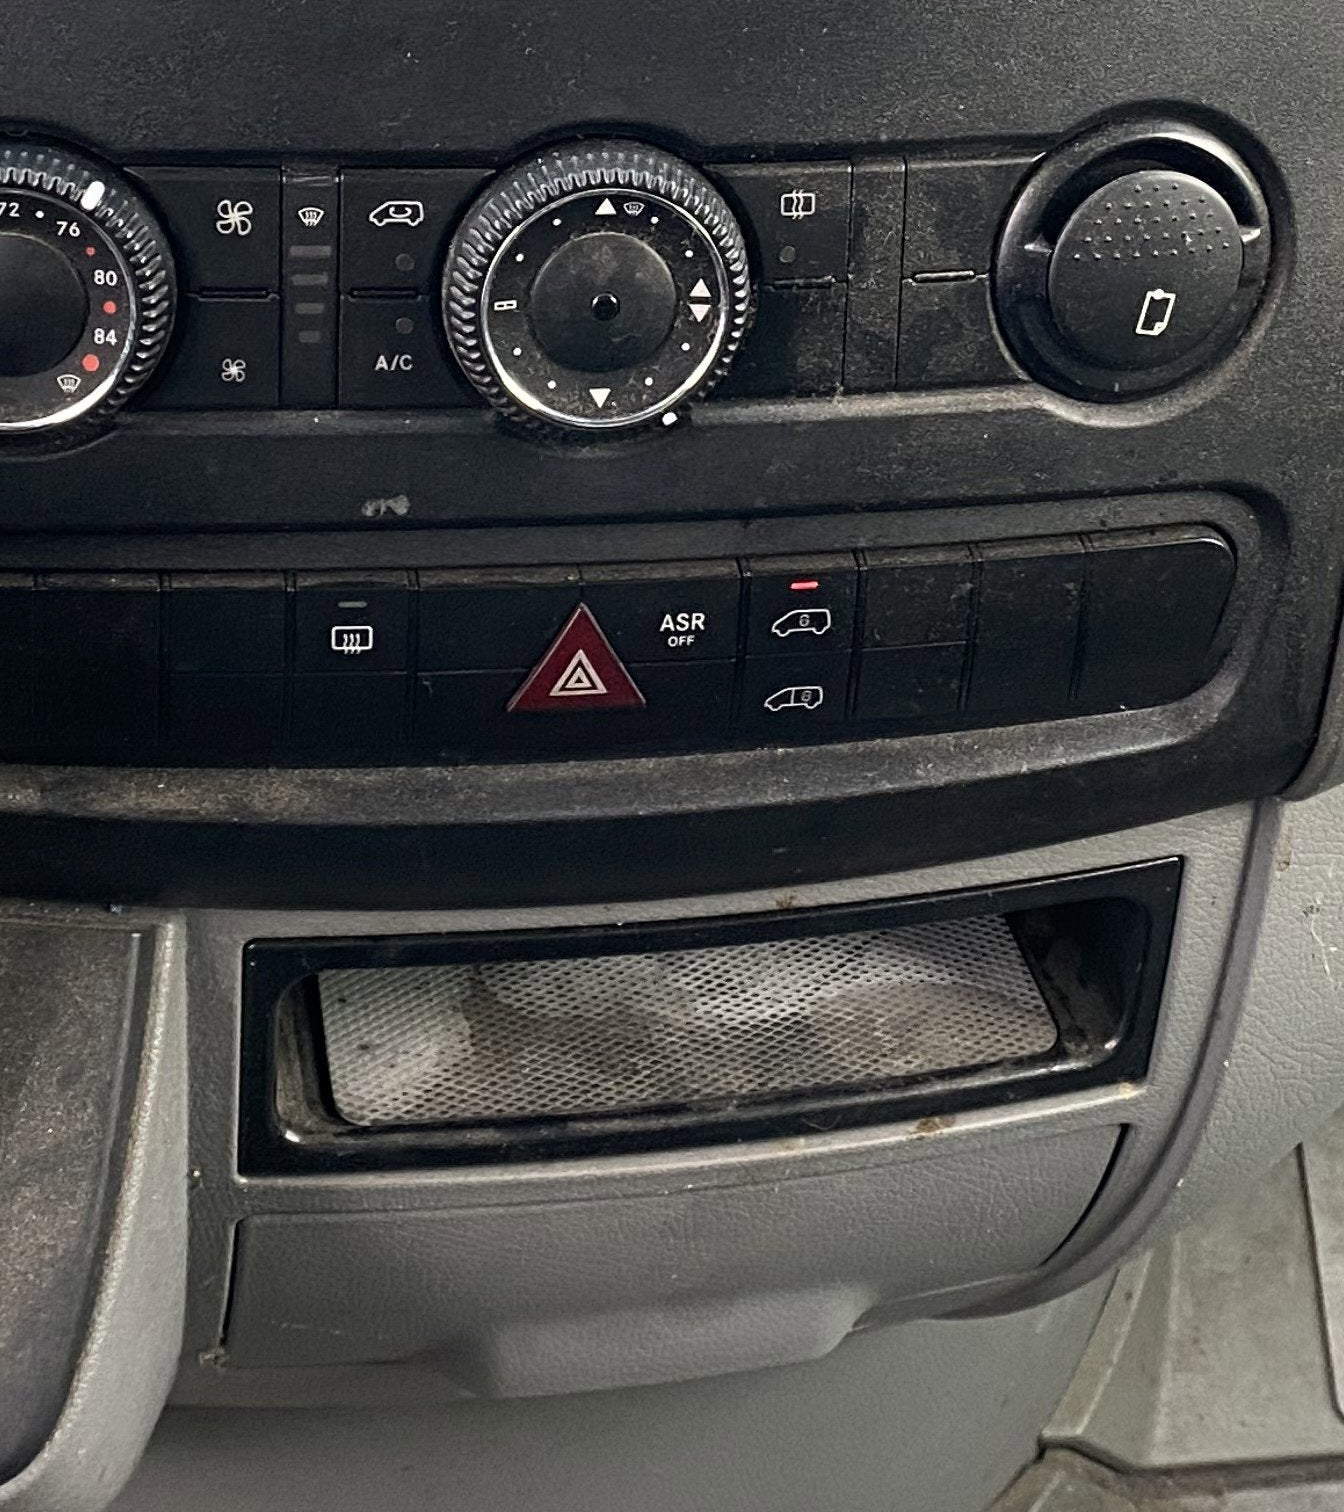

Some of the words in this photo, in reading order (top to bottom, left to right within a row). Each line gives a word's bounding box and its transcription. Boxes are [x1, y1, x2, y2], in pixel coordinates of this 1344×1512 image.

[56, 220, 81, 237] 76
[93, 269, 118, 287] 80
[93, 327, 118, 346] 84
[374, 354, 413, 371] A/C
[659, 612, 706, 632] ASR
[667, 634, 695, 647] OFF
